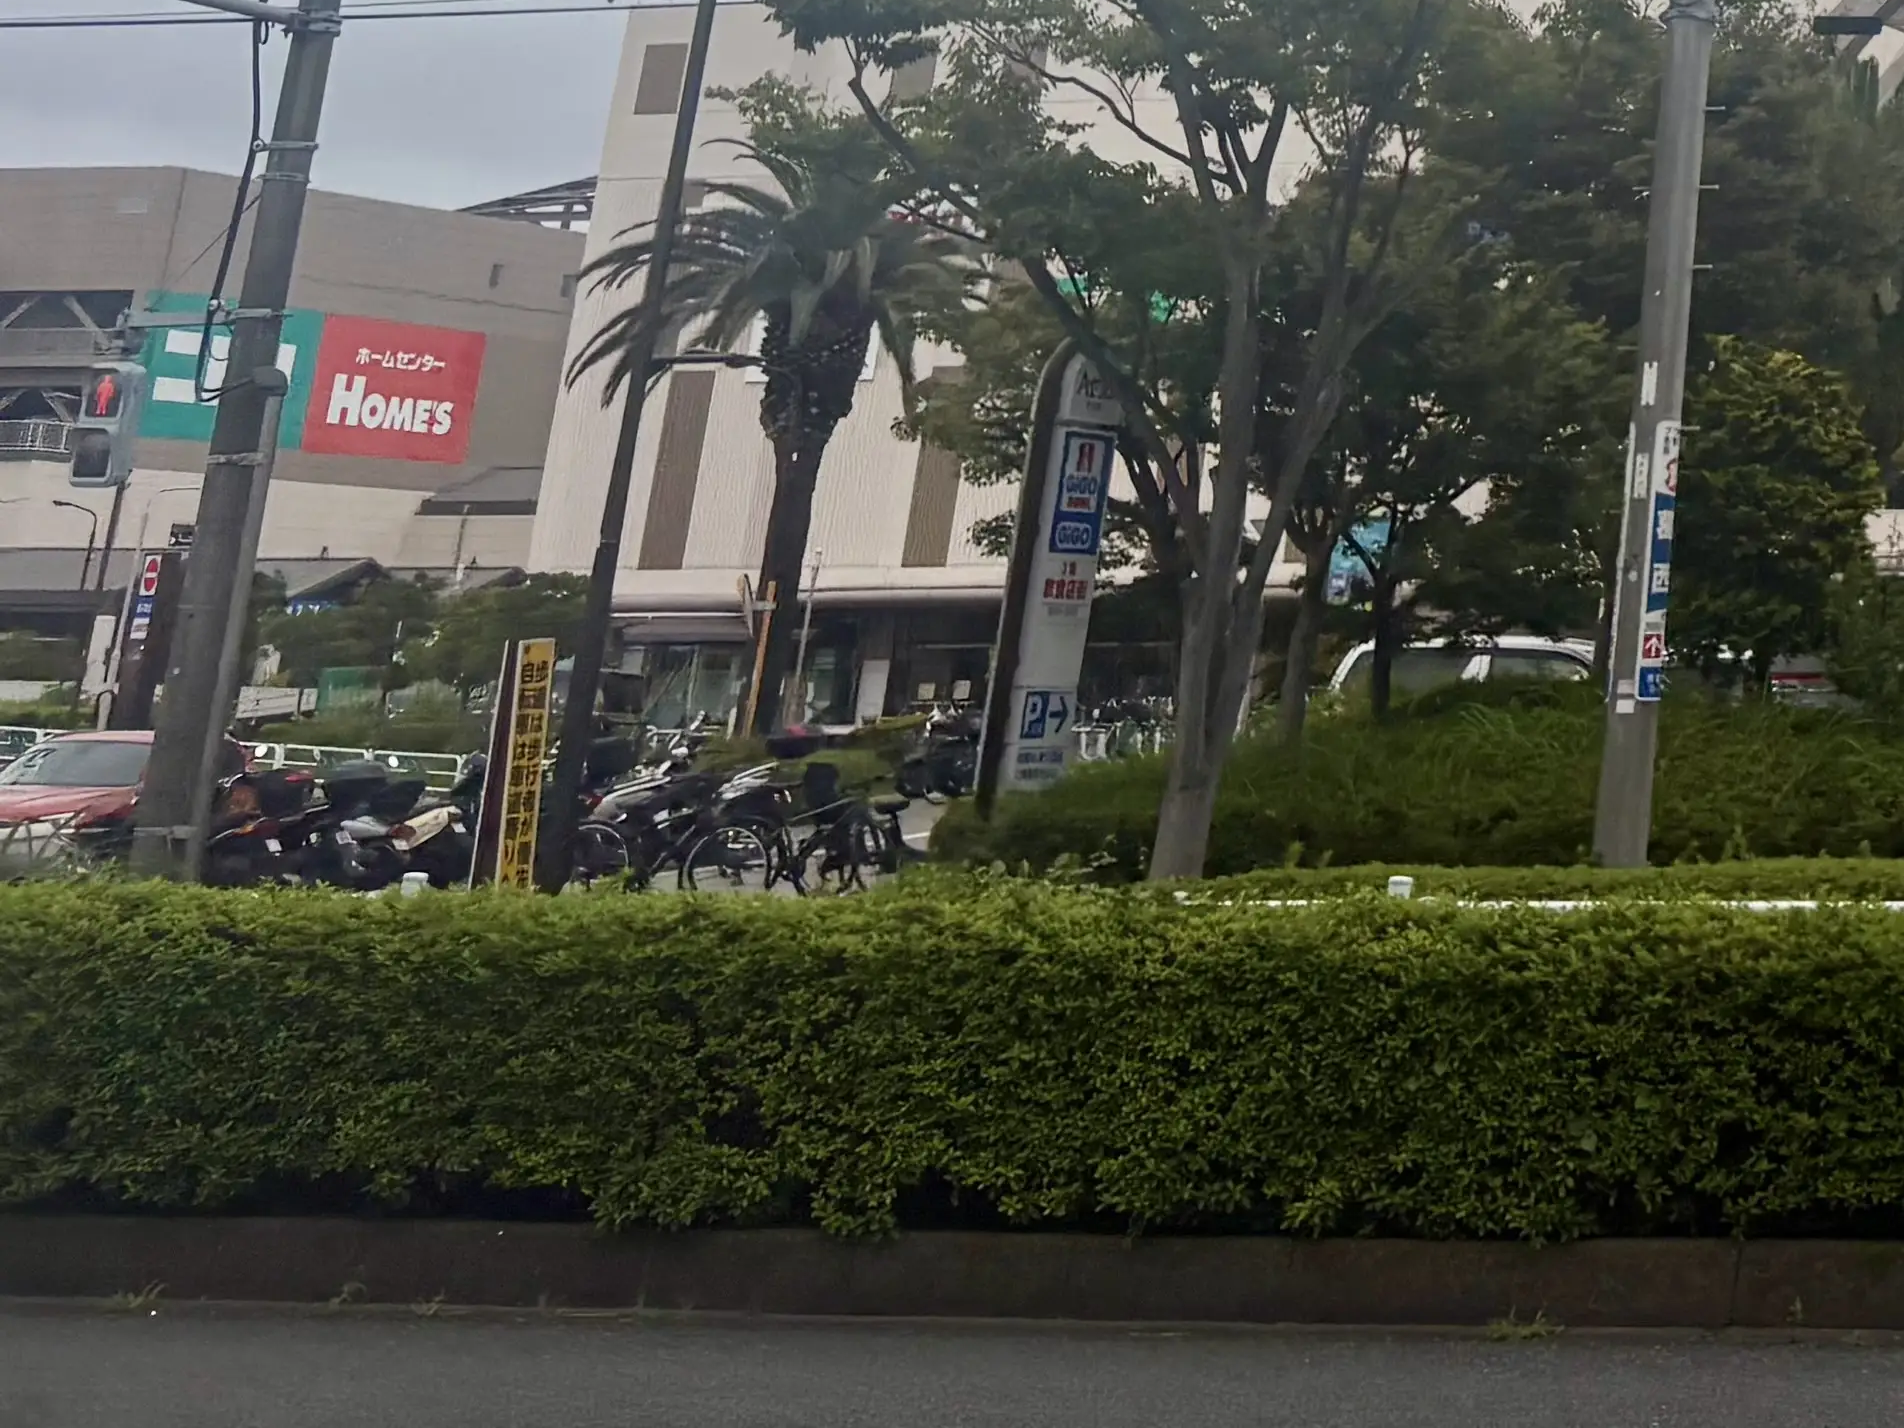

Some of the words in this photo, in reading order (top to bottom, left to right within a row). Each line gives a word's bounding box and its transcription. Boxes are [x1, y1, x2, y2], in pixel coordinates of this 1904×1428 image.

[355, 347, 446, 372] ホームセンター
[326, 373, 454, 435] HOME'S
